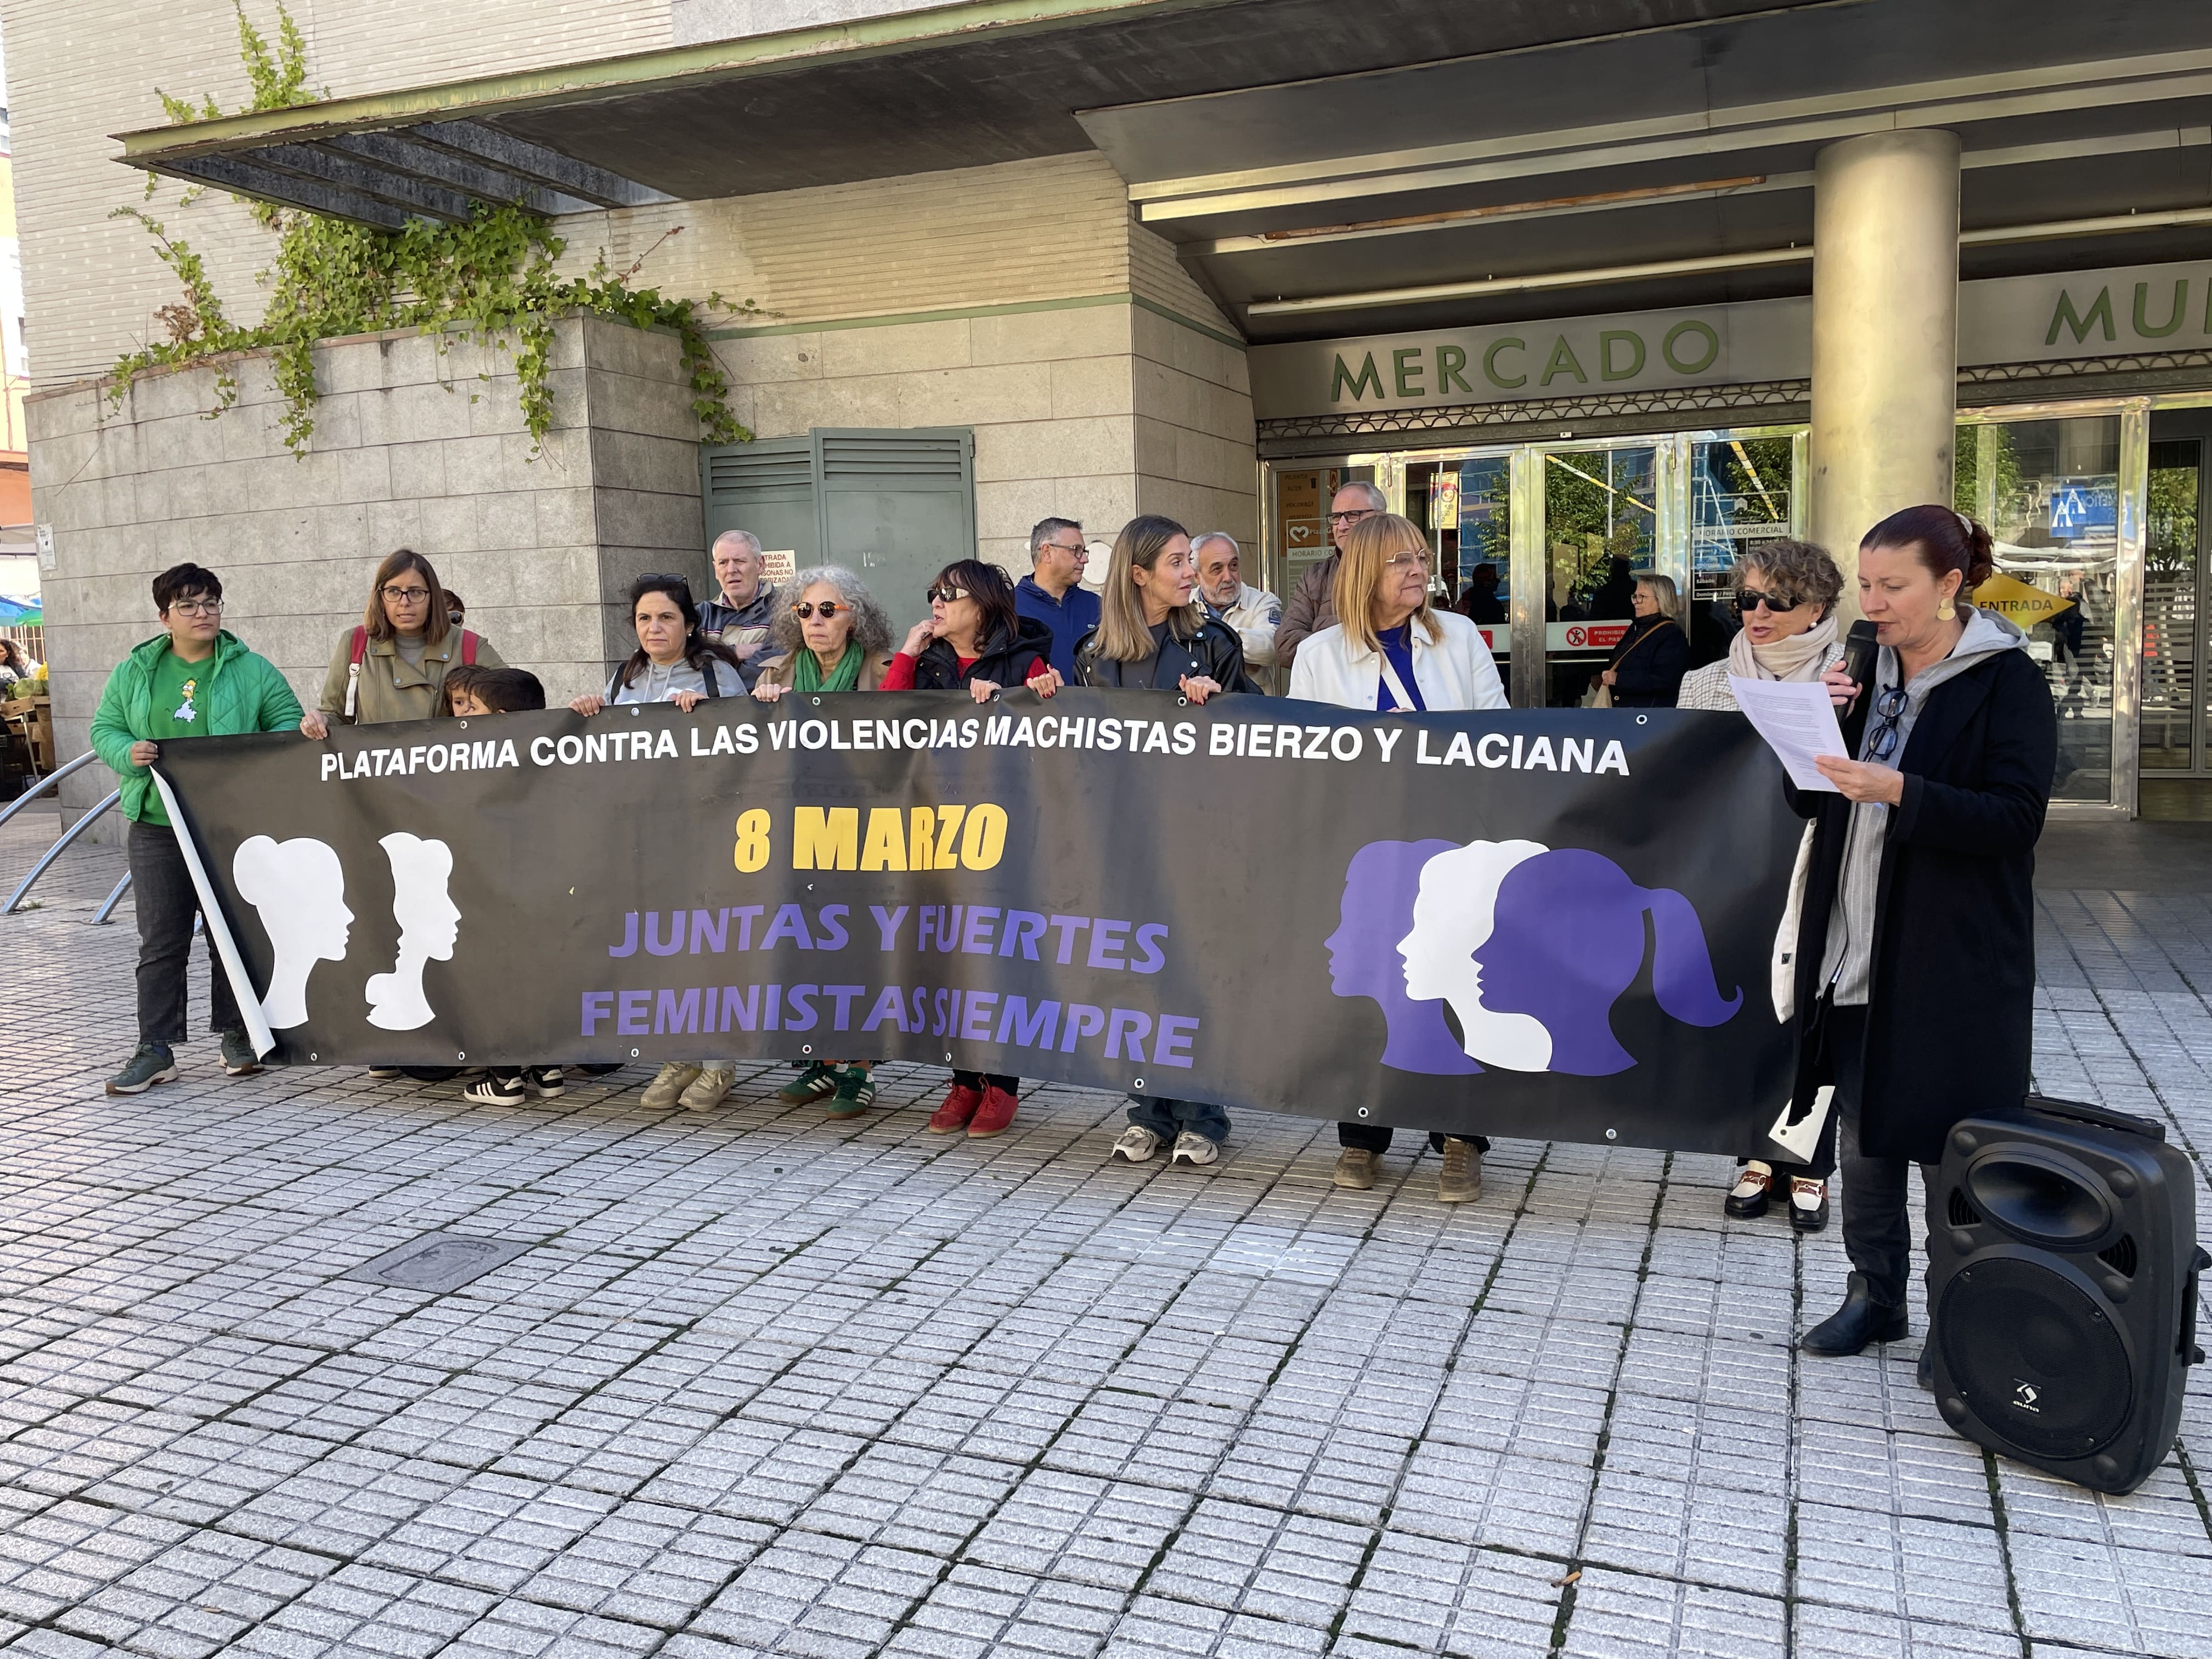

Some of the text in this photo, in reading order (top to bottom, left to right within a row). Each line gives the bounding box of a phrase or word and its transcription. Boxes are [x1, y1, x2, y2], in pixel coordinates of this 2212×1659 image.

[1330, 276, 2212, 402] MERCADO MU
[1737, 526, 1783, 535] COMERCIAL
[1980, 599, 2053, 612] ENTRADA
[321, 715, 1630, 781] PLATAFORMA CONTRA LAS VIOLENCIAS MACHISTAS BIERZO Y LACIANA
[733, 803, 1008, 873] 8 MARZO
[608, 904, 1169, 974] JUNTAS Y FUERTES
[580, 984, 1200, 1069] FEMINISTAS SIEMPRE
[2013, 1400, 2040, 1413] auna
